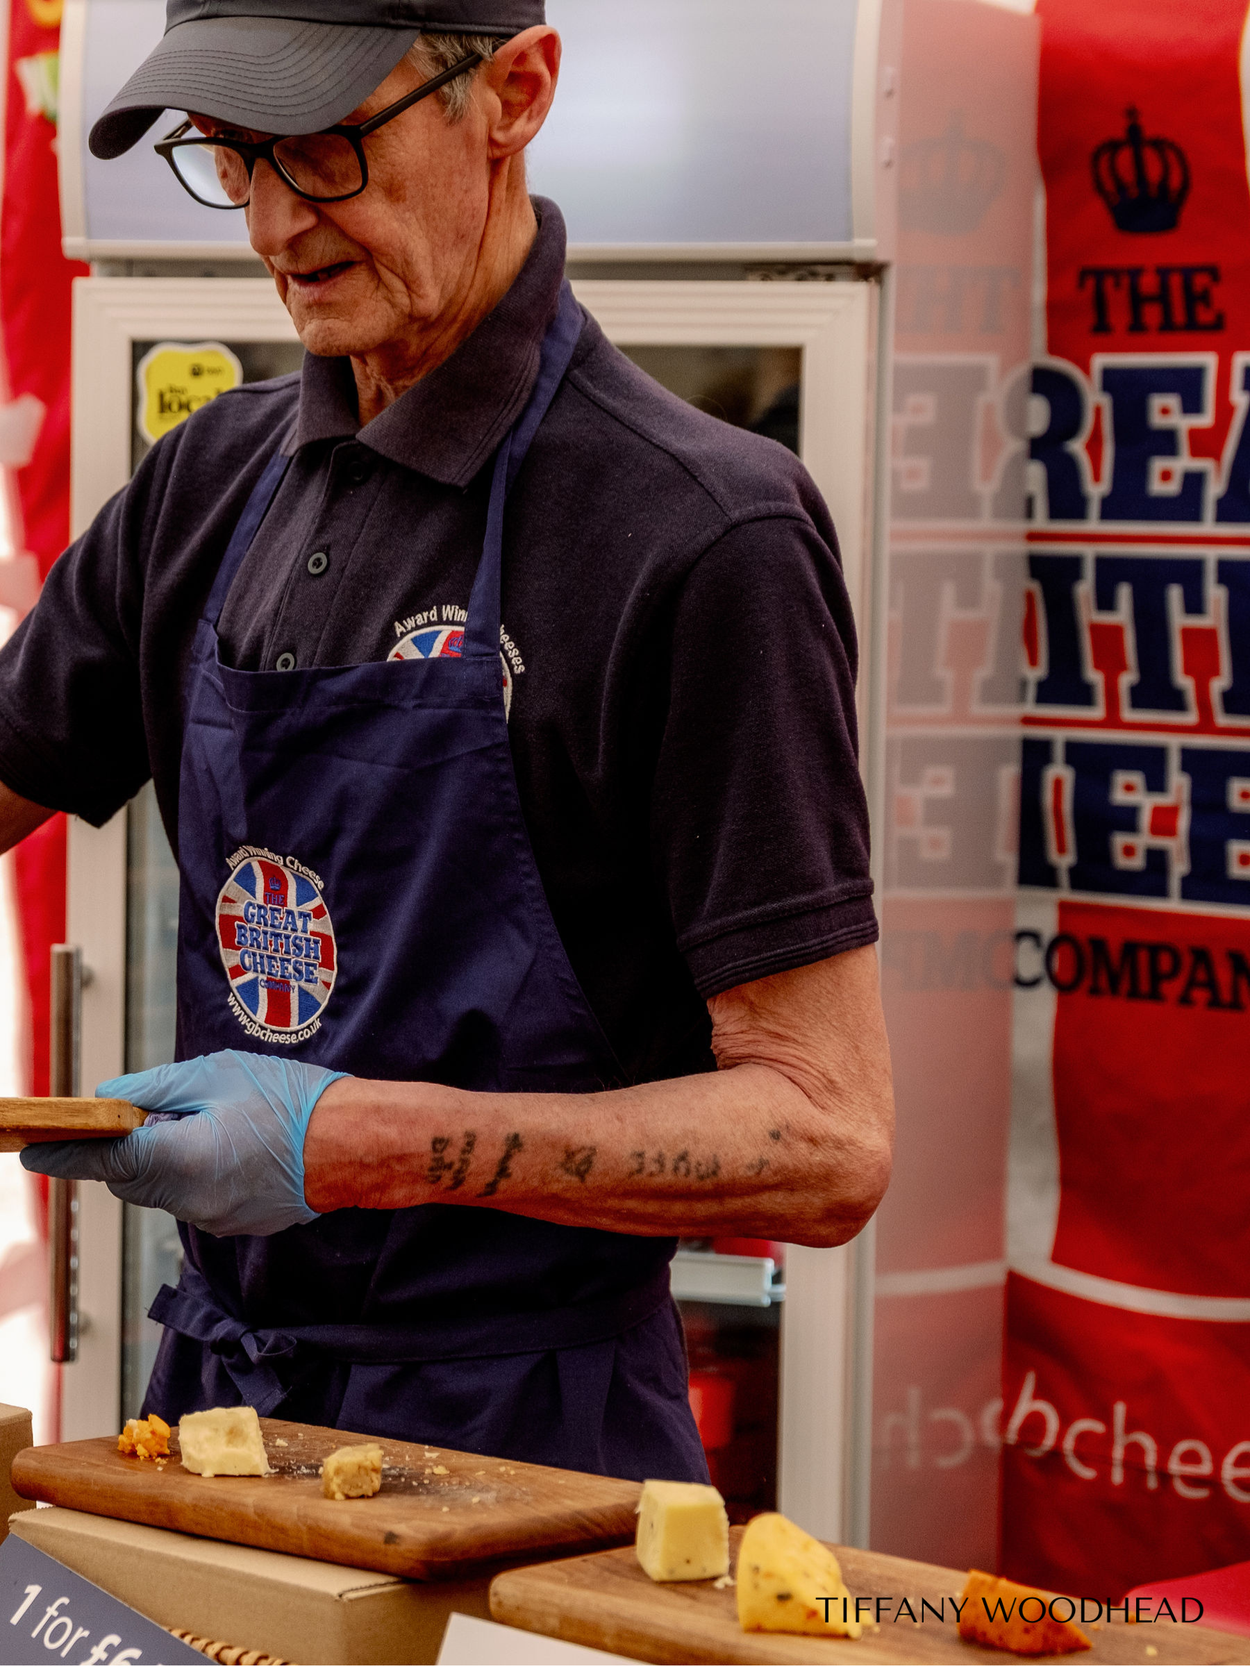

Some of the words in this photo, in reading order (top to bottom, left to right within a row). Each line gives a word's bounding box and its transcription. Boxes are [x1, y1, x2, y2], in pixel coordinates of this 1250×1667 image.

[1076, 264, 1226, 335] THE
[393, 605, 438, 638] Award
[225, 845, 250, 870] Award
[285, 855, 325, 891] Cheese
[264, 891, 285, 906] THE
[243, 901, 313, 936] GREAT
[235, 922, 321, 963] BRITISH
[239, 948, 320, 986] CHEESE
[259, 979, 296, 994] COMPANY
[9, 1583, 43, 1626] 1
[30, 1596, 90, 1659] for
